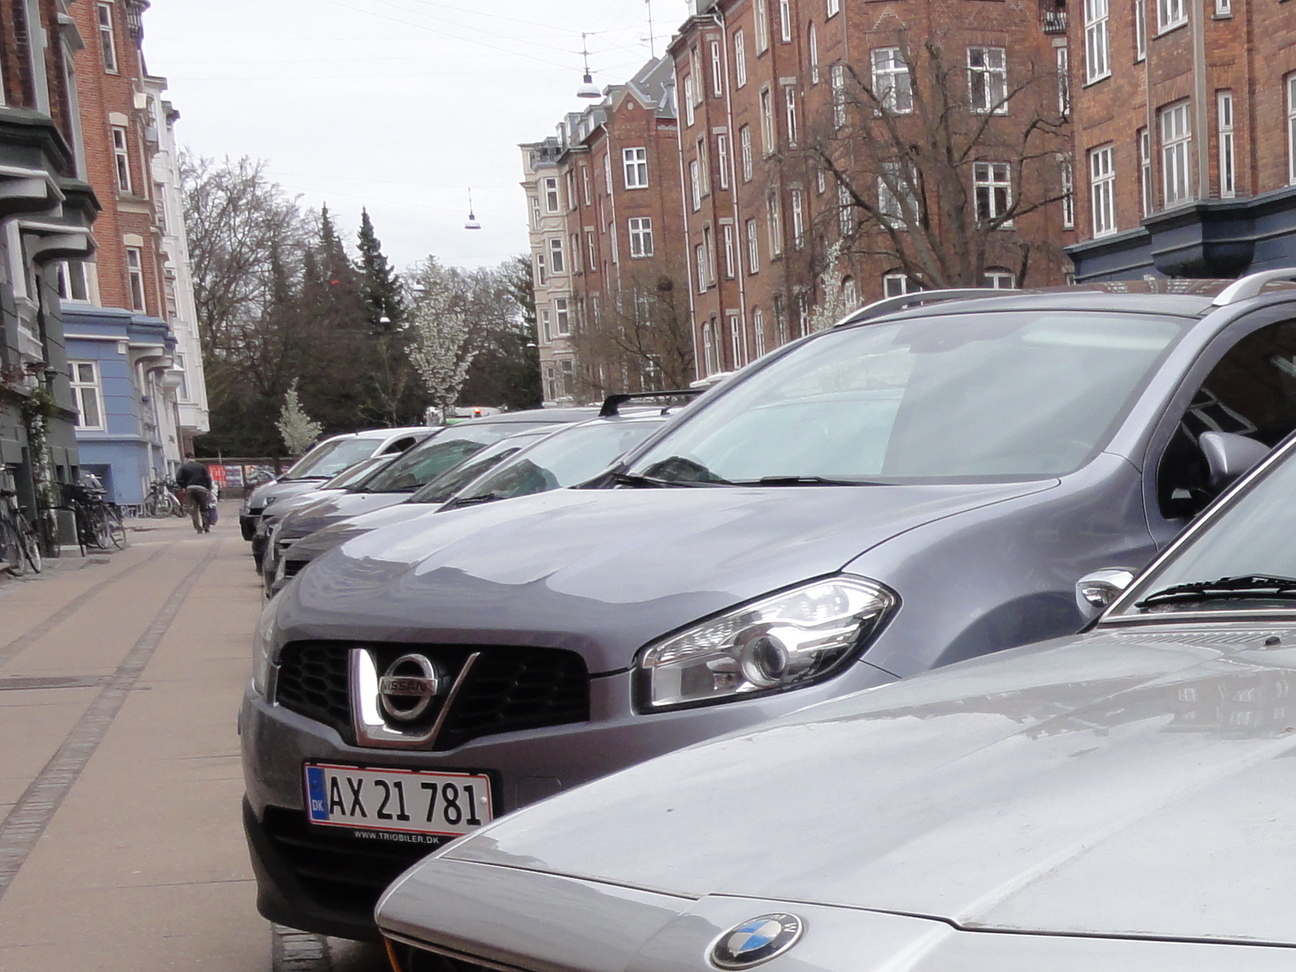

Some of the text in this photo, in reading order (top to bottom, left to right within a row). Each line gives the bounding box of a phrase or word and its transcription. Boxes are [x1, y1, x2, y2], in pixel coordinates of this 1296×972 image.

[382, 680, 428, 692] NISSAN
[312, 799, 324, 811] DK
[329, 776, 481, 826] AX 21 781
[354, 831, 440, 844] WWW.TRIOBILER.DK
